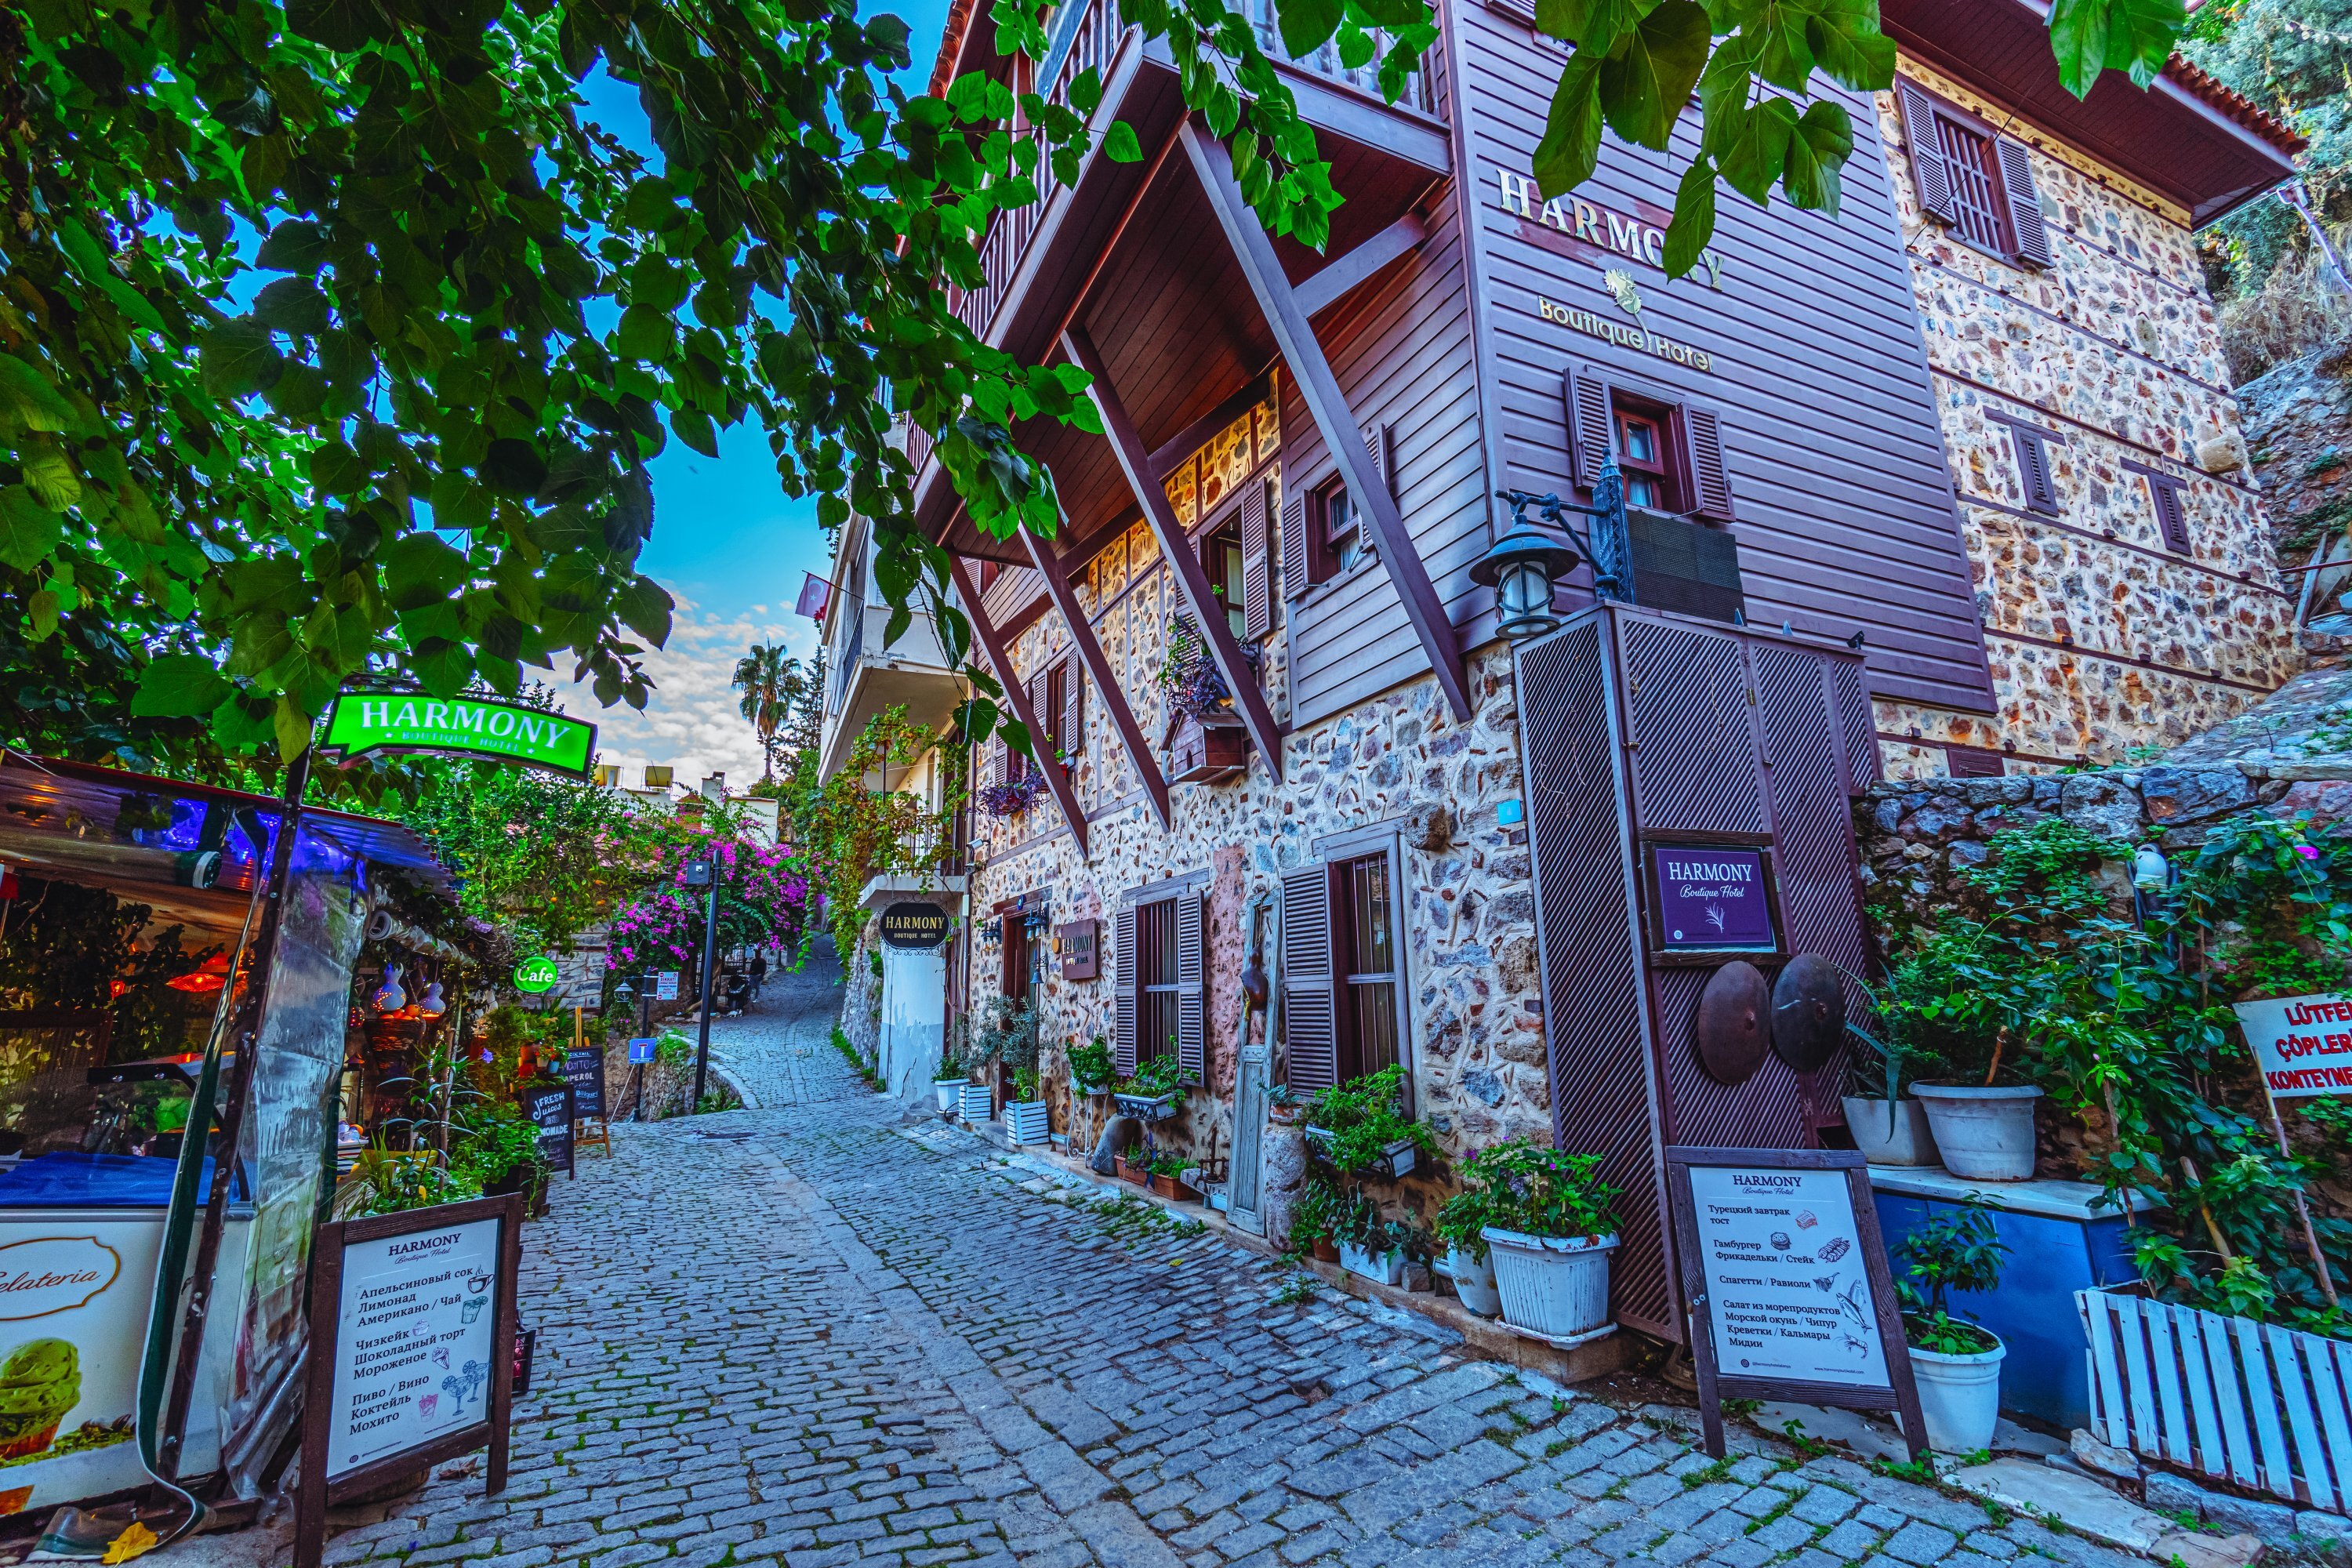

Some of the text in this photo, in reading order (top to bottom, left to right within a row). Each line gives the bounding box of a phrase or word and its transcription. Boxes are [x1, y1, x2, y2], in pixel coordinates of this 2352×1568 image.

[1497, 169, 1725, 292] HARMOY
[1538, 296, 1713, 374] Boutique Hotel
[361, 701, 571, 749] HARMONY
[402, 731, 519, 753] BOUTIQUE HOTEL
[1668, 862, 1752, 881] HARMONY
[1680, 884, 1744, 901] Boutique Hotel
[885, 916, 946, 929] HARMONY
[1062, 934, 1092, 954] HARMONY
[517, 966, 554, 982] Cafe
[2275, 1029, 2352, 1062] ÇÖPLER
[539, 1092, 564, 1106] FRESH
[1733, 1175, 1802, 1187] HARMONY
[1742, 1186, 1773, 1196] Boutique
[1708, 1205, 1791, 1216] Турецкий завтрак
[388, 1232, 462, 1256] HARMONY
[1713, 1240, 1761, 1250] Гамбургер
[395, 1247, 451, 1265] Boutique Hotel
[1715, 1251, 1778, 1262] Фрикадельки
[1786, 1254, 1815, 1264] Стейк
[359, 1268, 474, 1299] Апельсиновый сок
[1719, 1276, 1762, 1286] Спагетти
[1770, 1278, 1811, 1288] Равиоли
[358, 1294, 416, 1313] Лимонад
[358, 1303, 429, 1327] Американо
[441, 1294, 462, 1306] Чай
[1723, 1300, 1750, 1309] Салат
[1766, 1304, 1841, 1315] морепродуктов
[1725, 1312, 1767, 1323] Морской
[1769, 1316, 1798, 1326] окунь
[1806, 1317, 1837, 1329] Чипур
[356, 1329, 409, 1350] Чизкейк
[1726, 1325, 1772, 1336] Креветки
[1780, 1328, 1831, 1341] Кальмары
[354, 1328, 466, 1366] Шоколадный торт
[1729, 1338, 1763, 1348] Мидии
[353, 1352, 426, 1380] Мороженое
[352, 1389, 386, 1406] Пиво
[398, 1375, 429, 1392] Вино
[350, 1393, 411, 1421] Коктейль
[349, 1412, 400, 1436] Мохито
